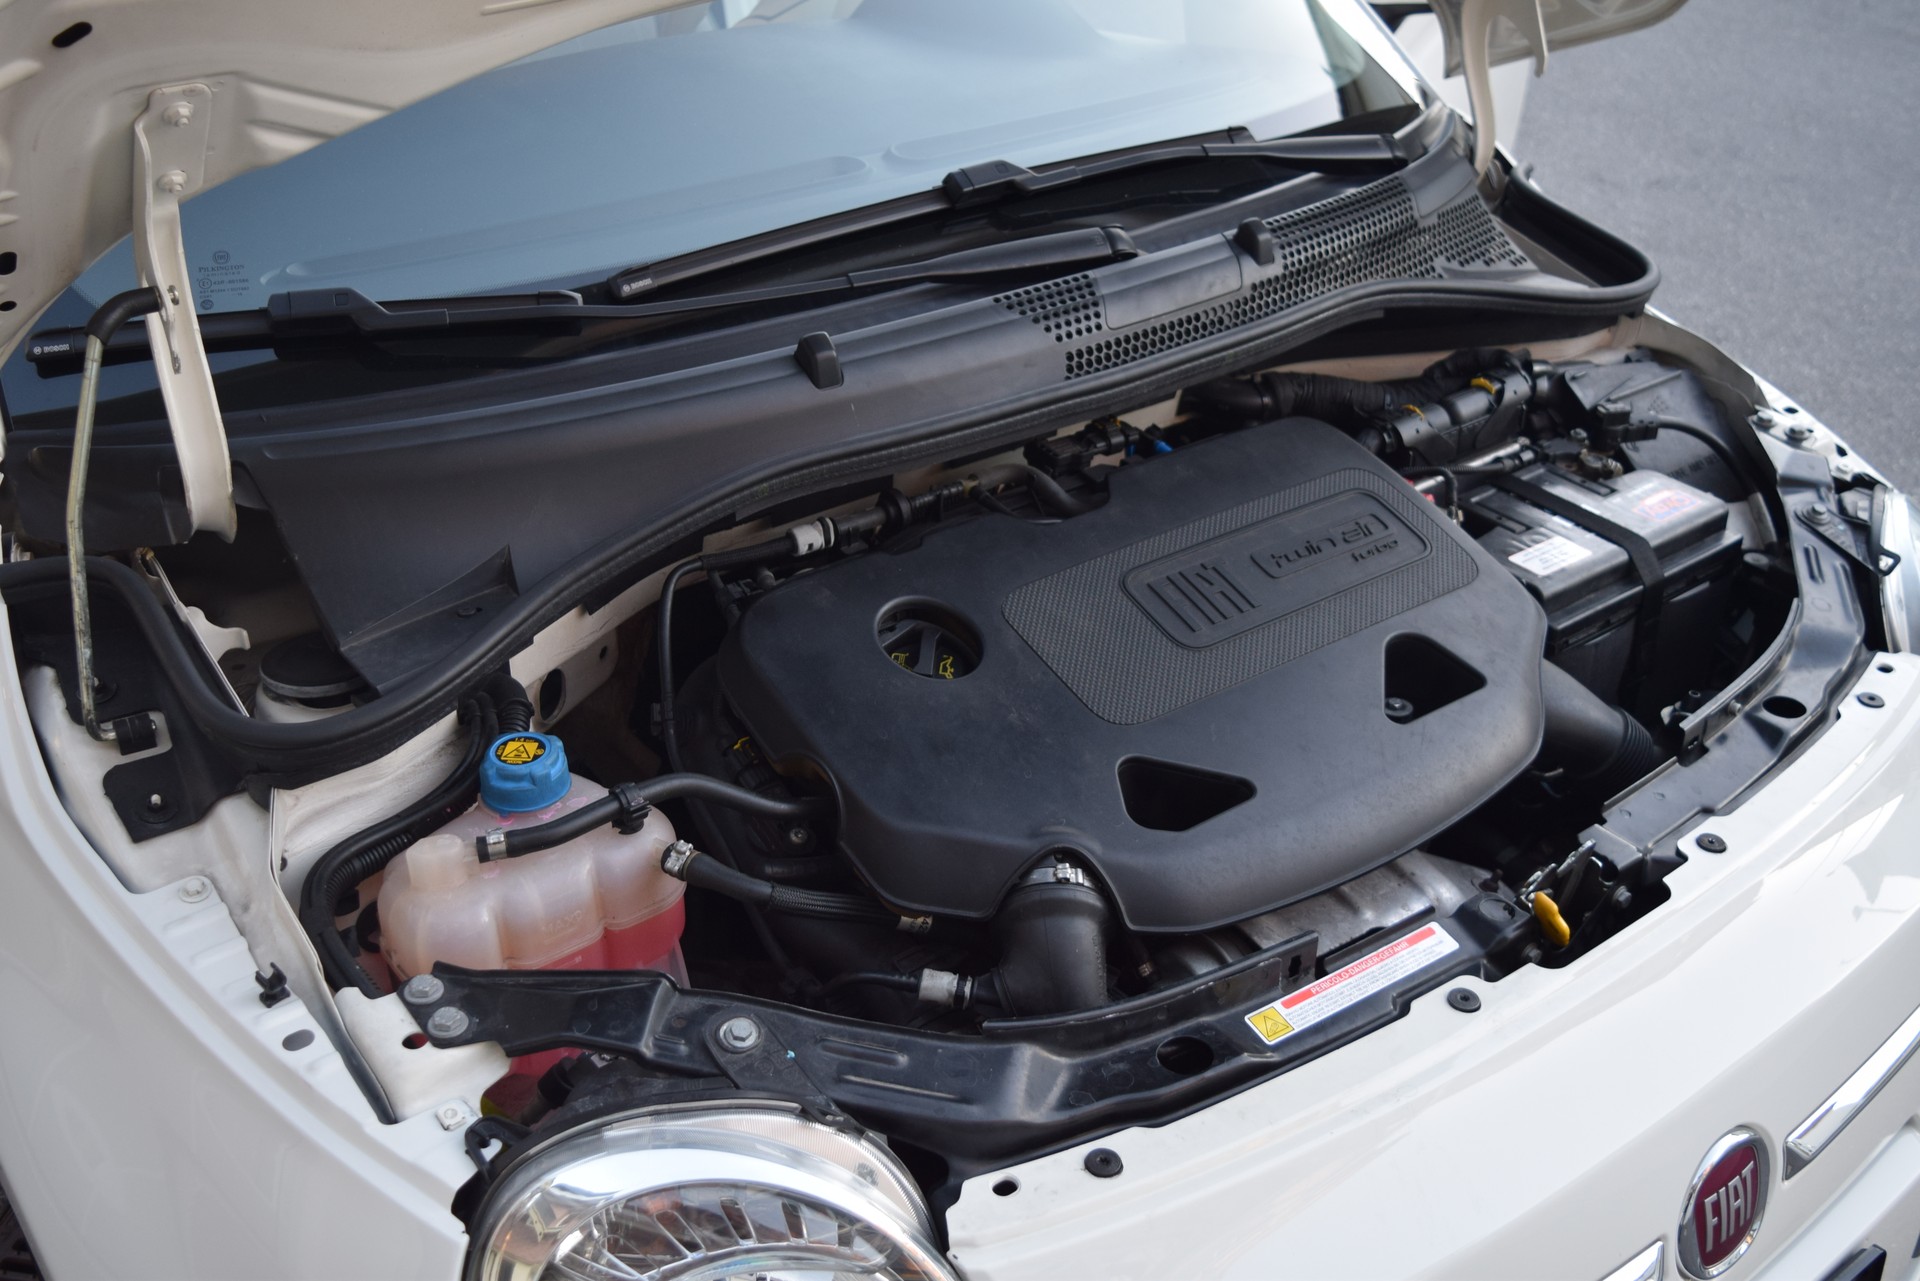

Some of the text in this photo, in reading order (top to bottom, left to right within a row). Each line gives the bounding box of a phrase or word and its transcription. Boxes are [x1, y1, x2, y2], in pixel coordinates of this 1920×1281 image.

[198, 264, 245, 273] PILKINGTON
[629, 278, 653, 290] BOSCH
[43, 343, 70, 353] BOSCH
[1351, 538, 1399, 564] turbo
[1145, 559, 1263, 634] FIAT
[1310, 940, 1410, 996] PERICOLO-DANGER-GEFAHR
[1703, 1159, 1755, 1255] FIAT
